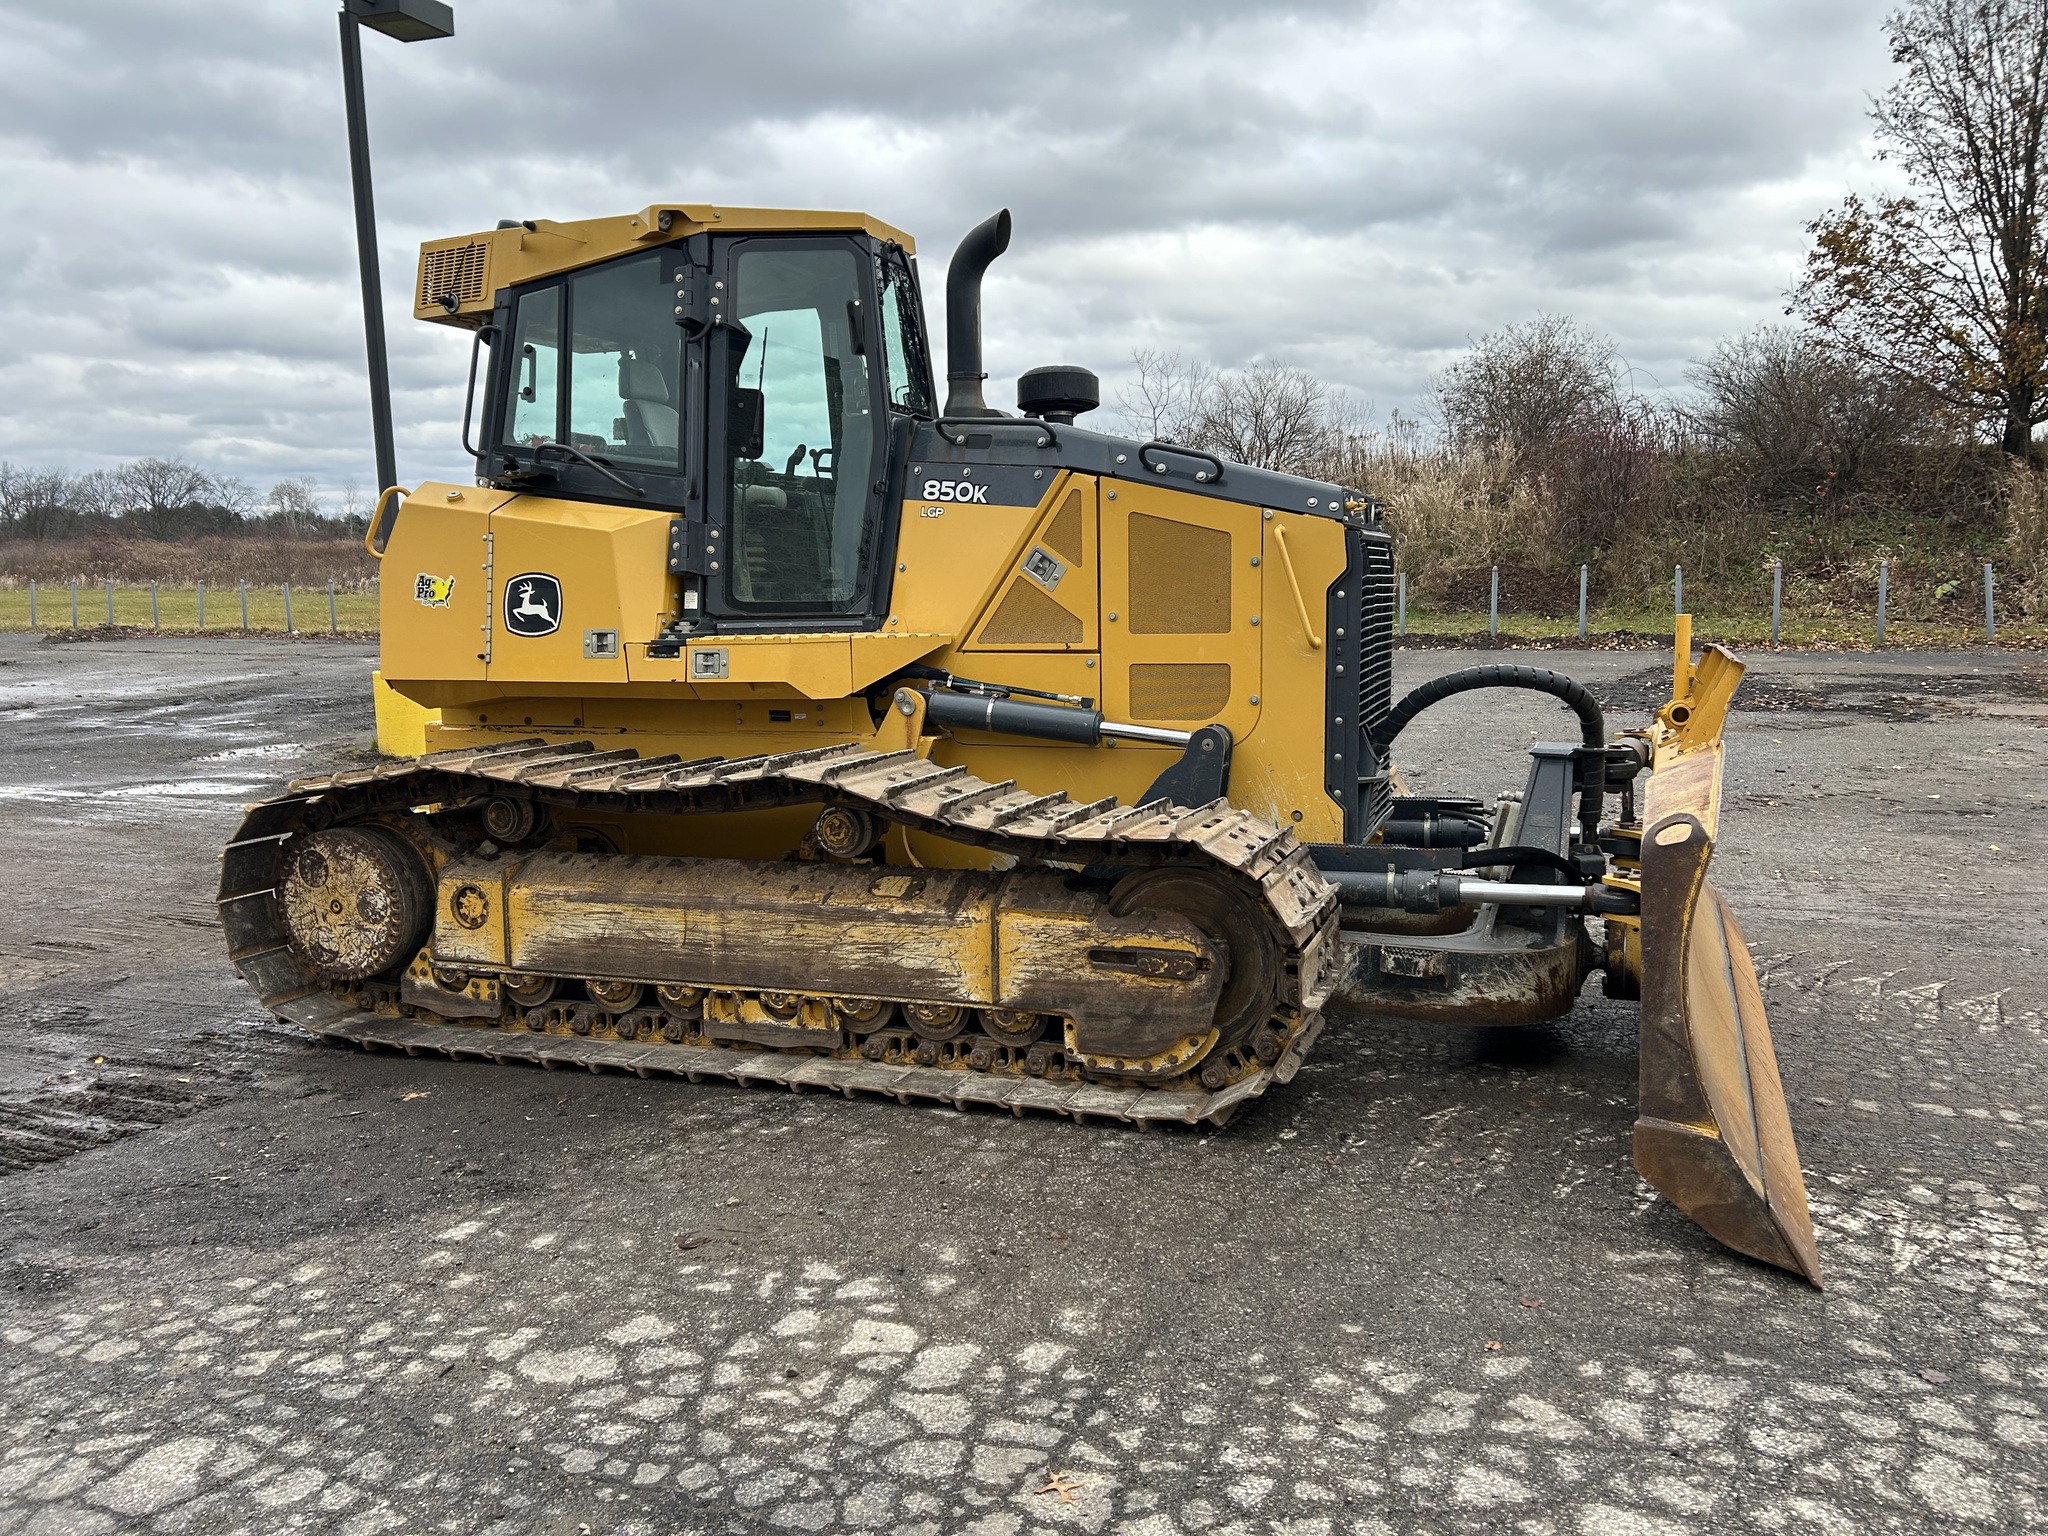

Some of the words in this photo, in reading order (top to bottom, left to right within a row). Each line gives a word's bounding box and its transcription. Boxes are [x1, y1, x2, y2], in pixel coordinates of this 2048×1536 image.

[922, 479, 989, 504] 850K
[920, 506, 945, 518] LGP
[417, 575, 436, 589] Ag-
[416, 587, 436, 598] Pro
